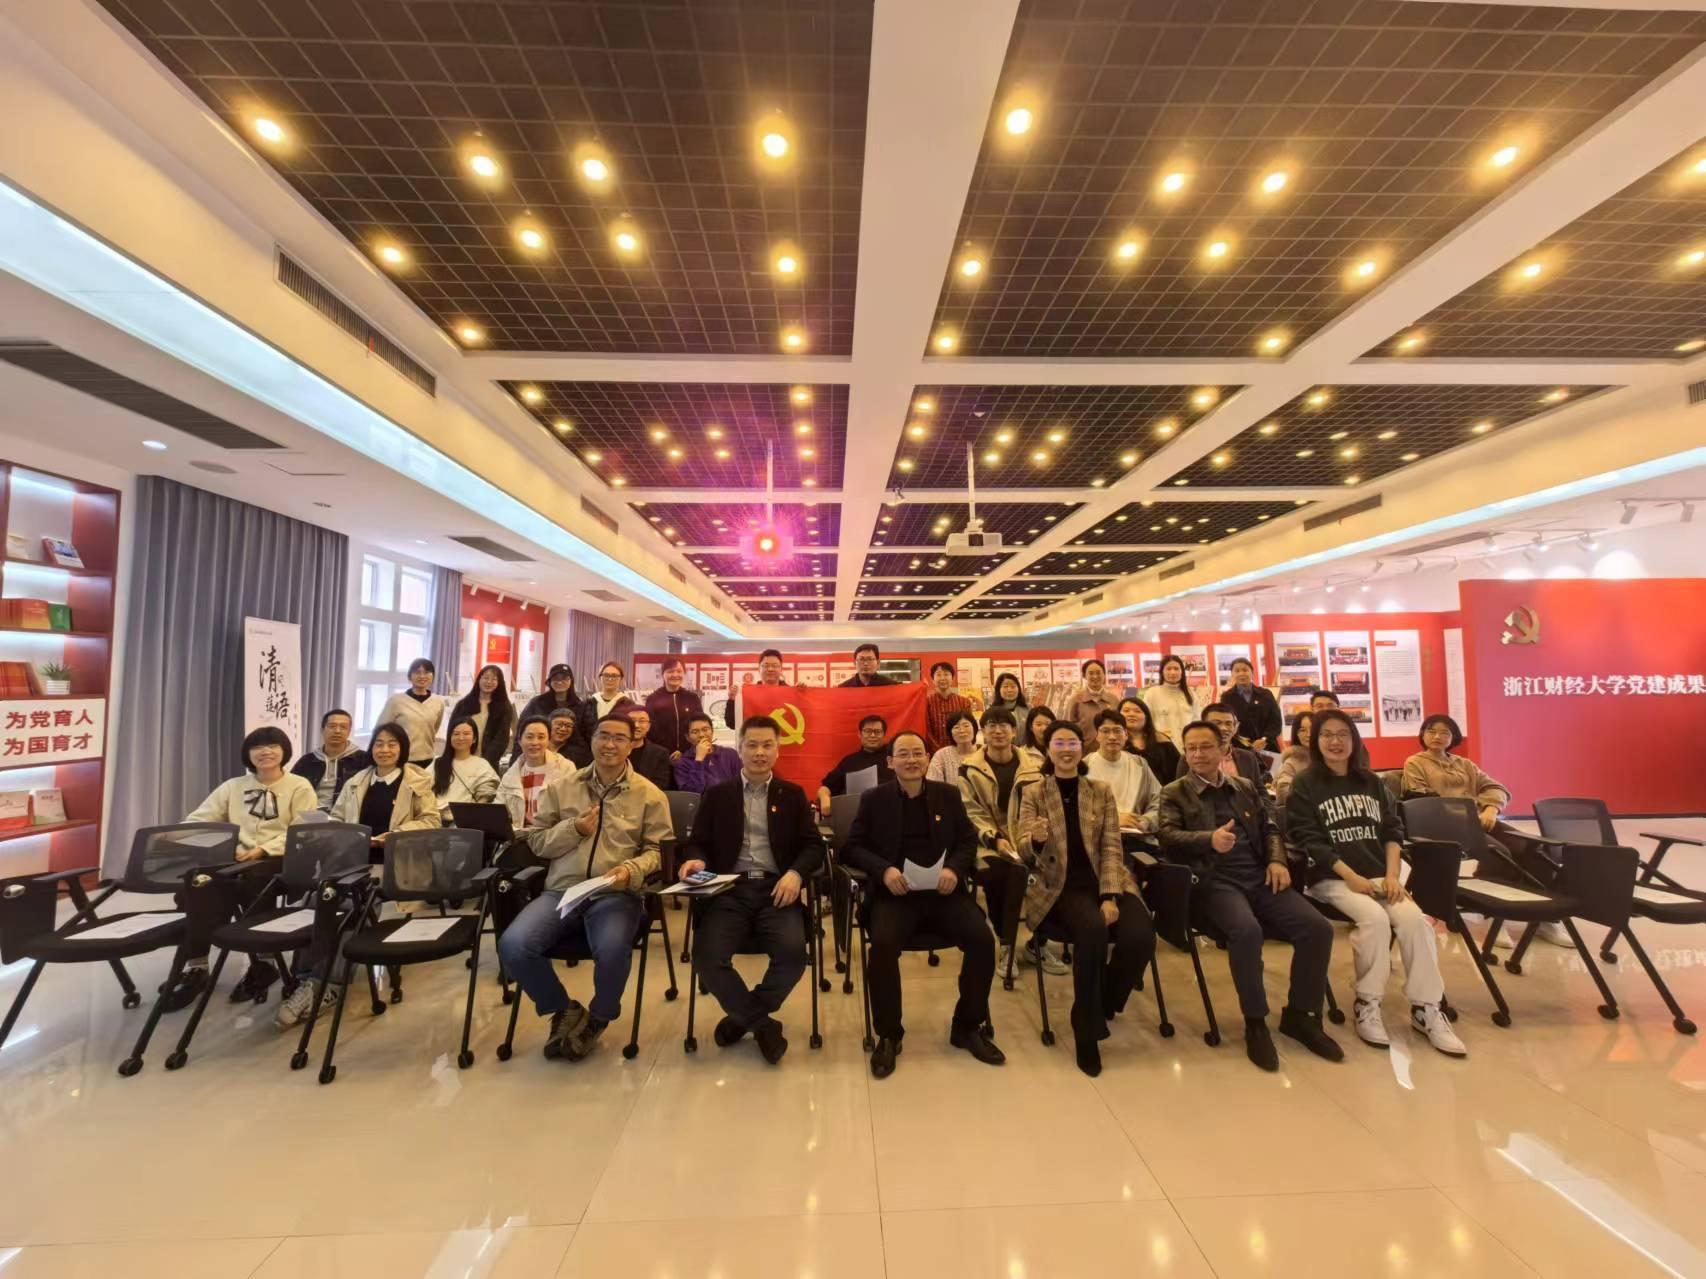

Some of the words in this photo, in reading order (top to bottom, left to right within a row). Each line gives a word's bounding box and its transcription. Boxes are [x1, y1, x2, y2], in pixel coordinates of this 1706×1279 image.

[1503, 675, 1706, 696] 浙江财经大学党建成果
[5, 708, 94, 729] 为党育人
[3, 733, 93, 756] 为国育才
[1329, 825, 1378, 843] FOOTBAL
